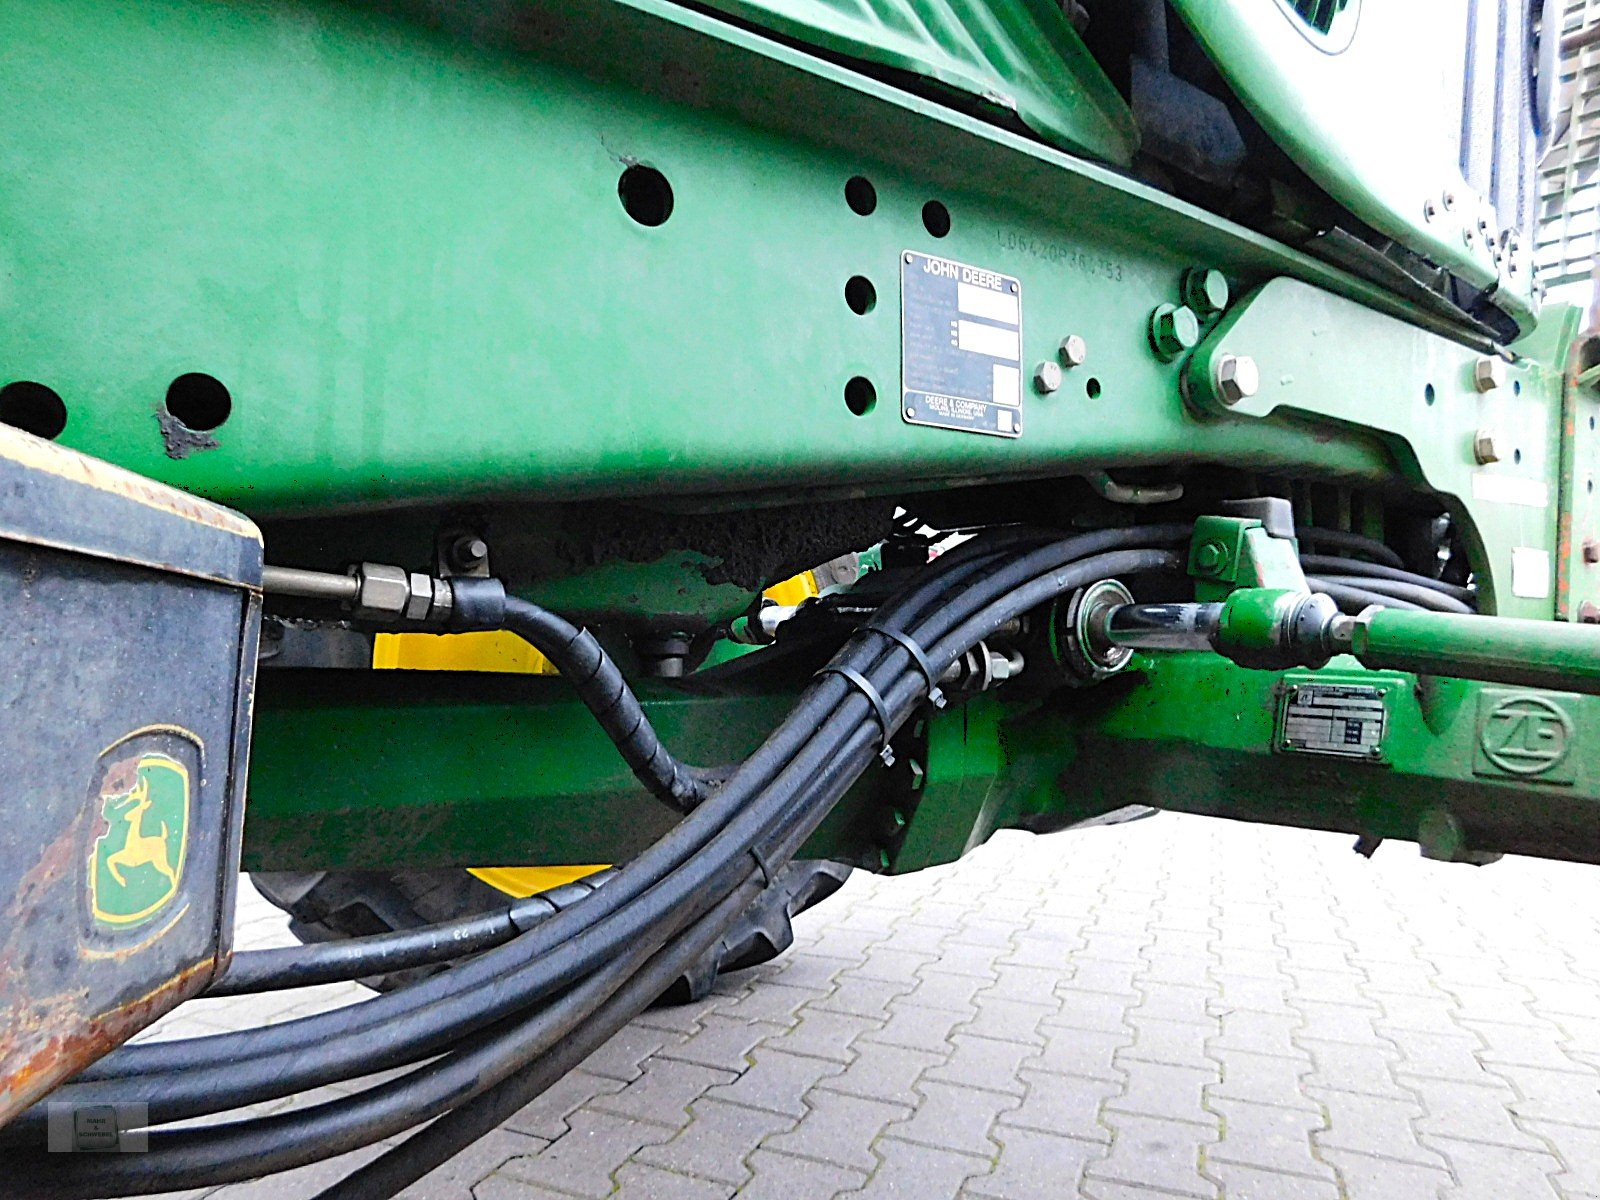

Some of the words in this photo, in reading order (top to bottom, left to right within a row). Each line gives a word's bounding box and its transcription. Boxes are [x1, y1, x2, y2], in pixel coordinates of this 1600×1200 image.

[923, 258, 959, 280] JOHN
[962, 267, 1003, 291] DEERE
[925, 395, 948, 406] DEERE
[955, 400, 987, 413] COMPANY
[1489, 706, 1564, 763] ZF
